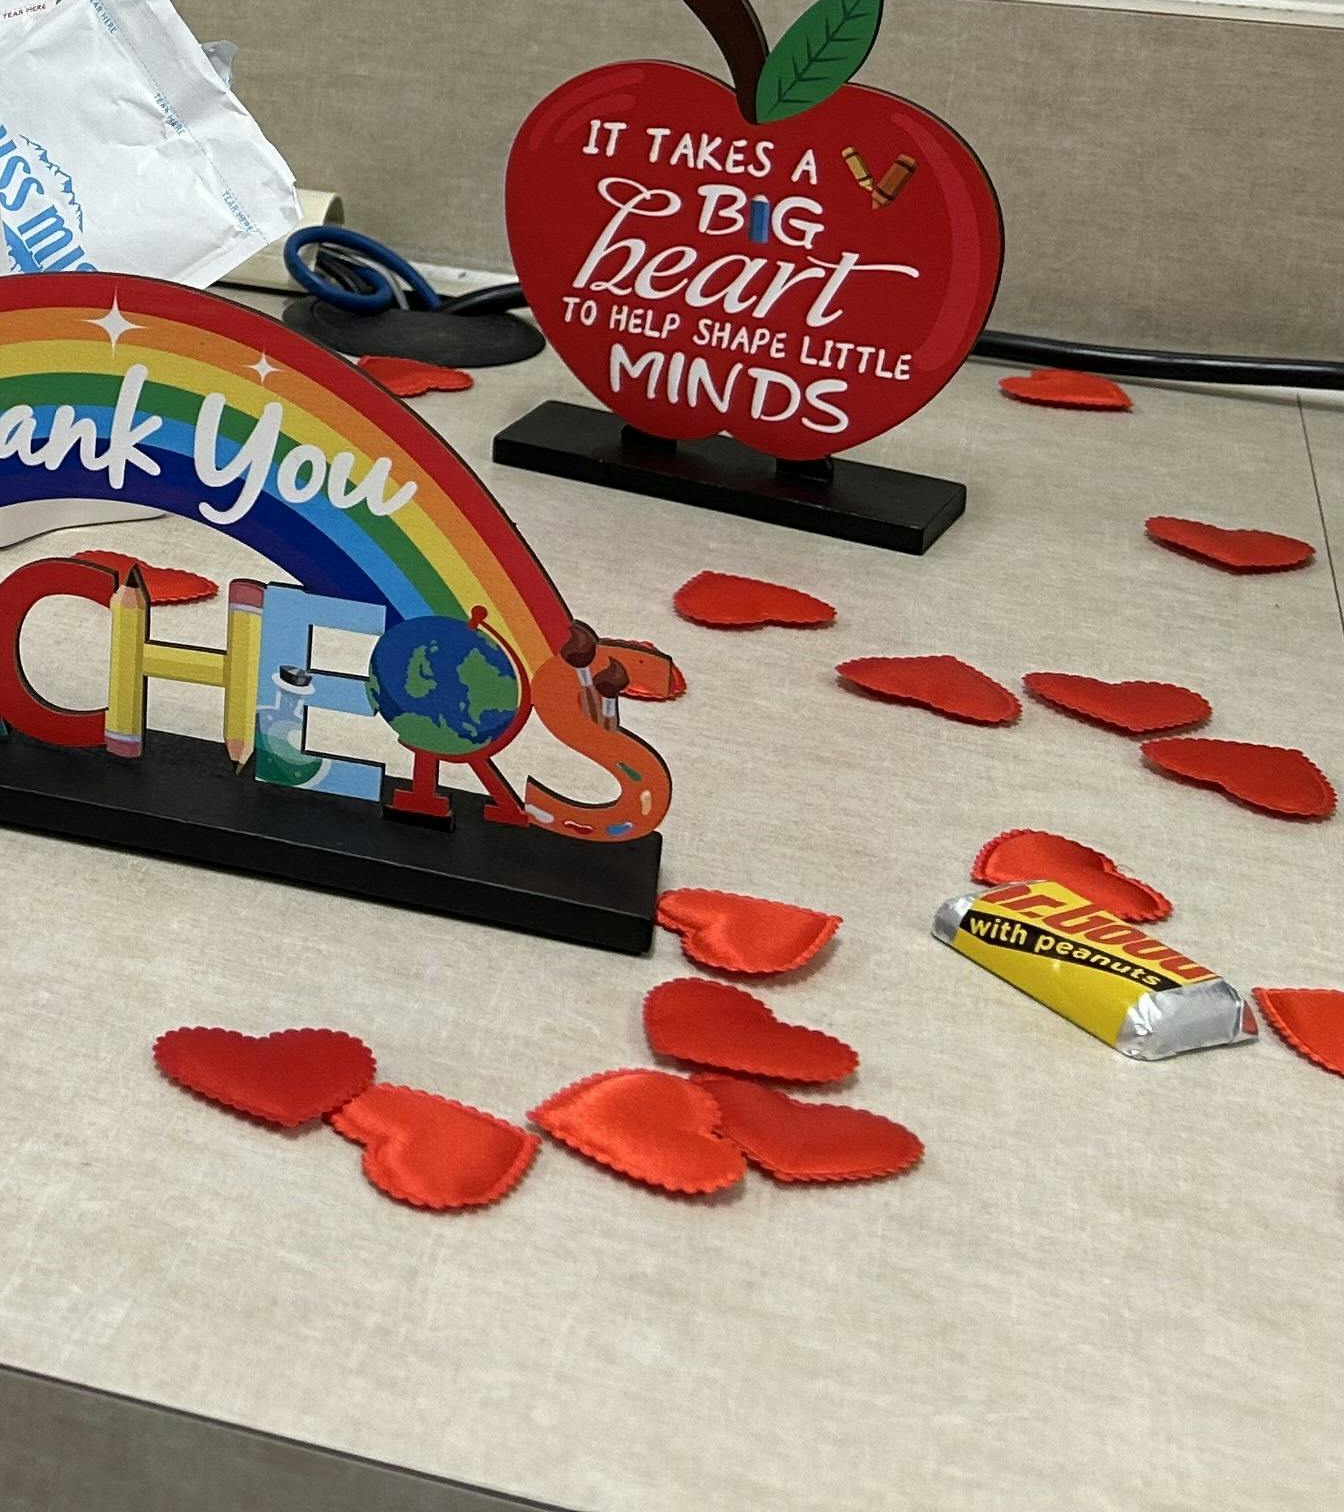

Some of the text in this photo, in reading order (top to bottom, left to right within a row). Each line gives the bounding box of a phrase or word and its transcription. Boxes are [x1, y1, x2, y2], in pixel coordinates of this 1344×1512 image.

[2, 3, 46, 19] TEAR HERE
[583, 119, 818, 184] IT TAKES A
[572, 176, 919, 328] heart
[696, 184, 825, 249] BIG
[562, 296, 912, 381] TO HELP SHAPE LITTLE
[609, 342, 849, 434] MINDS
[188, 391, 419, 526] You
[969, 917, 1162, 987] with peanuts
